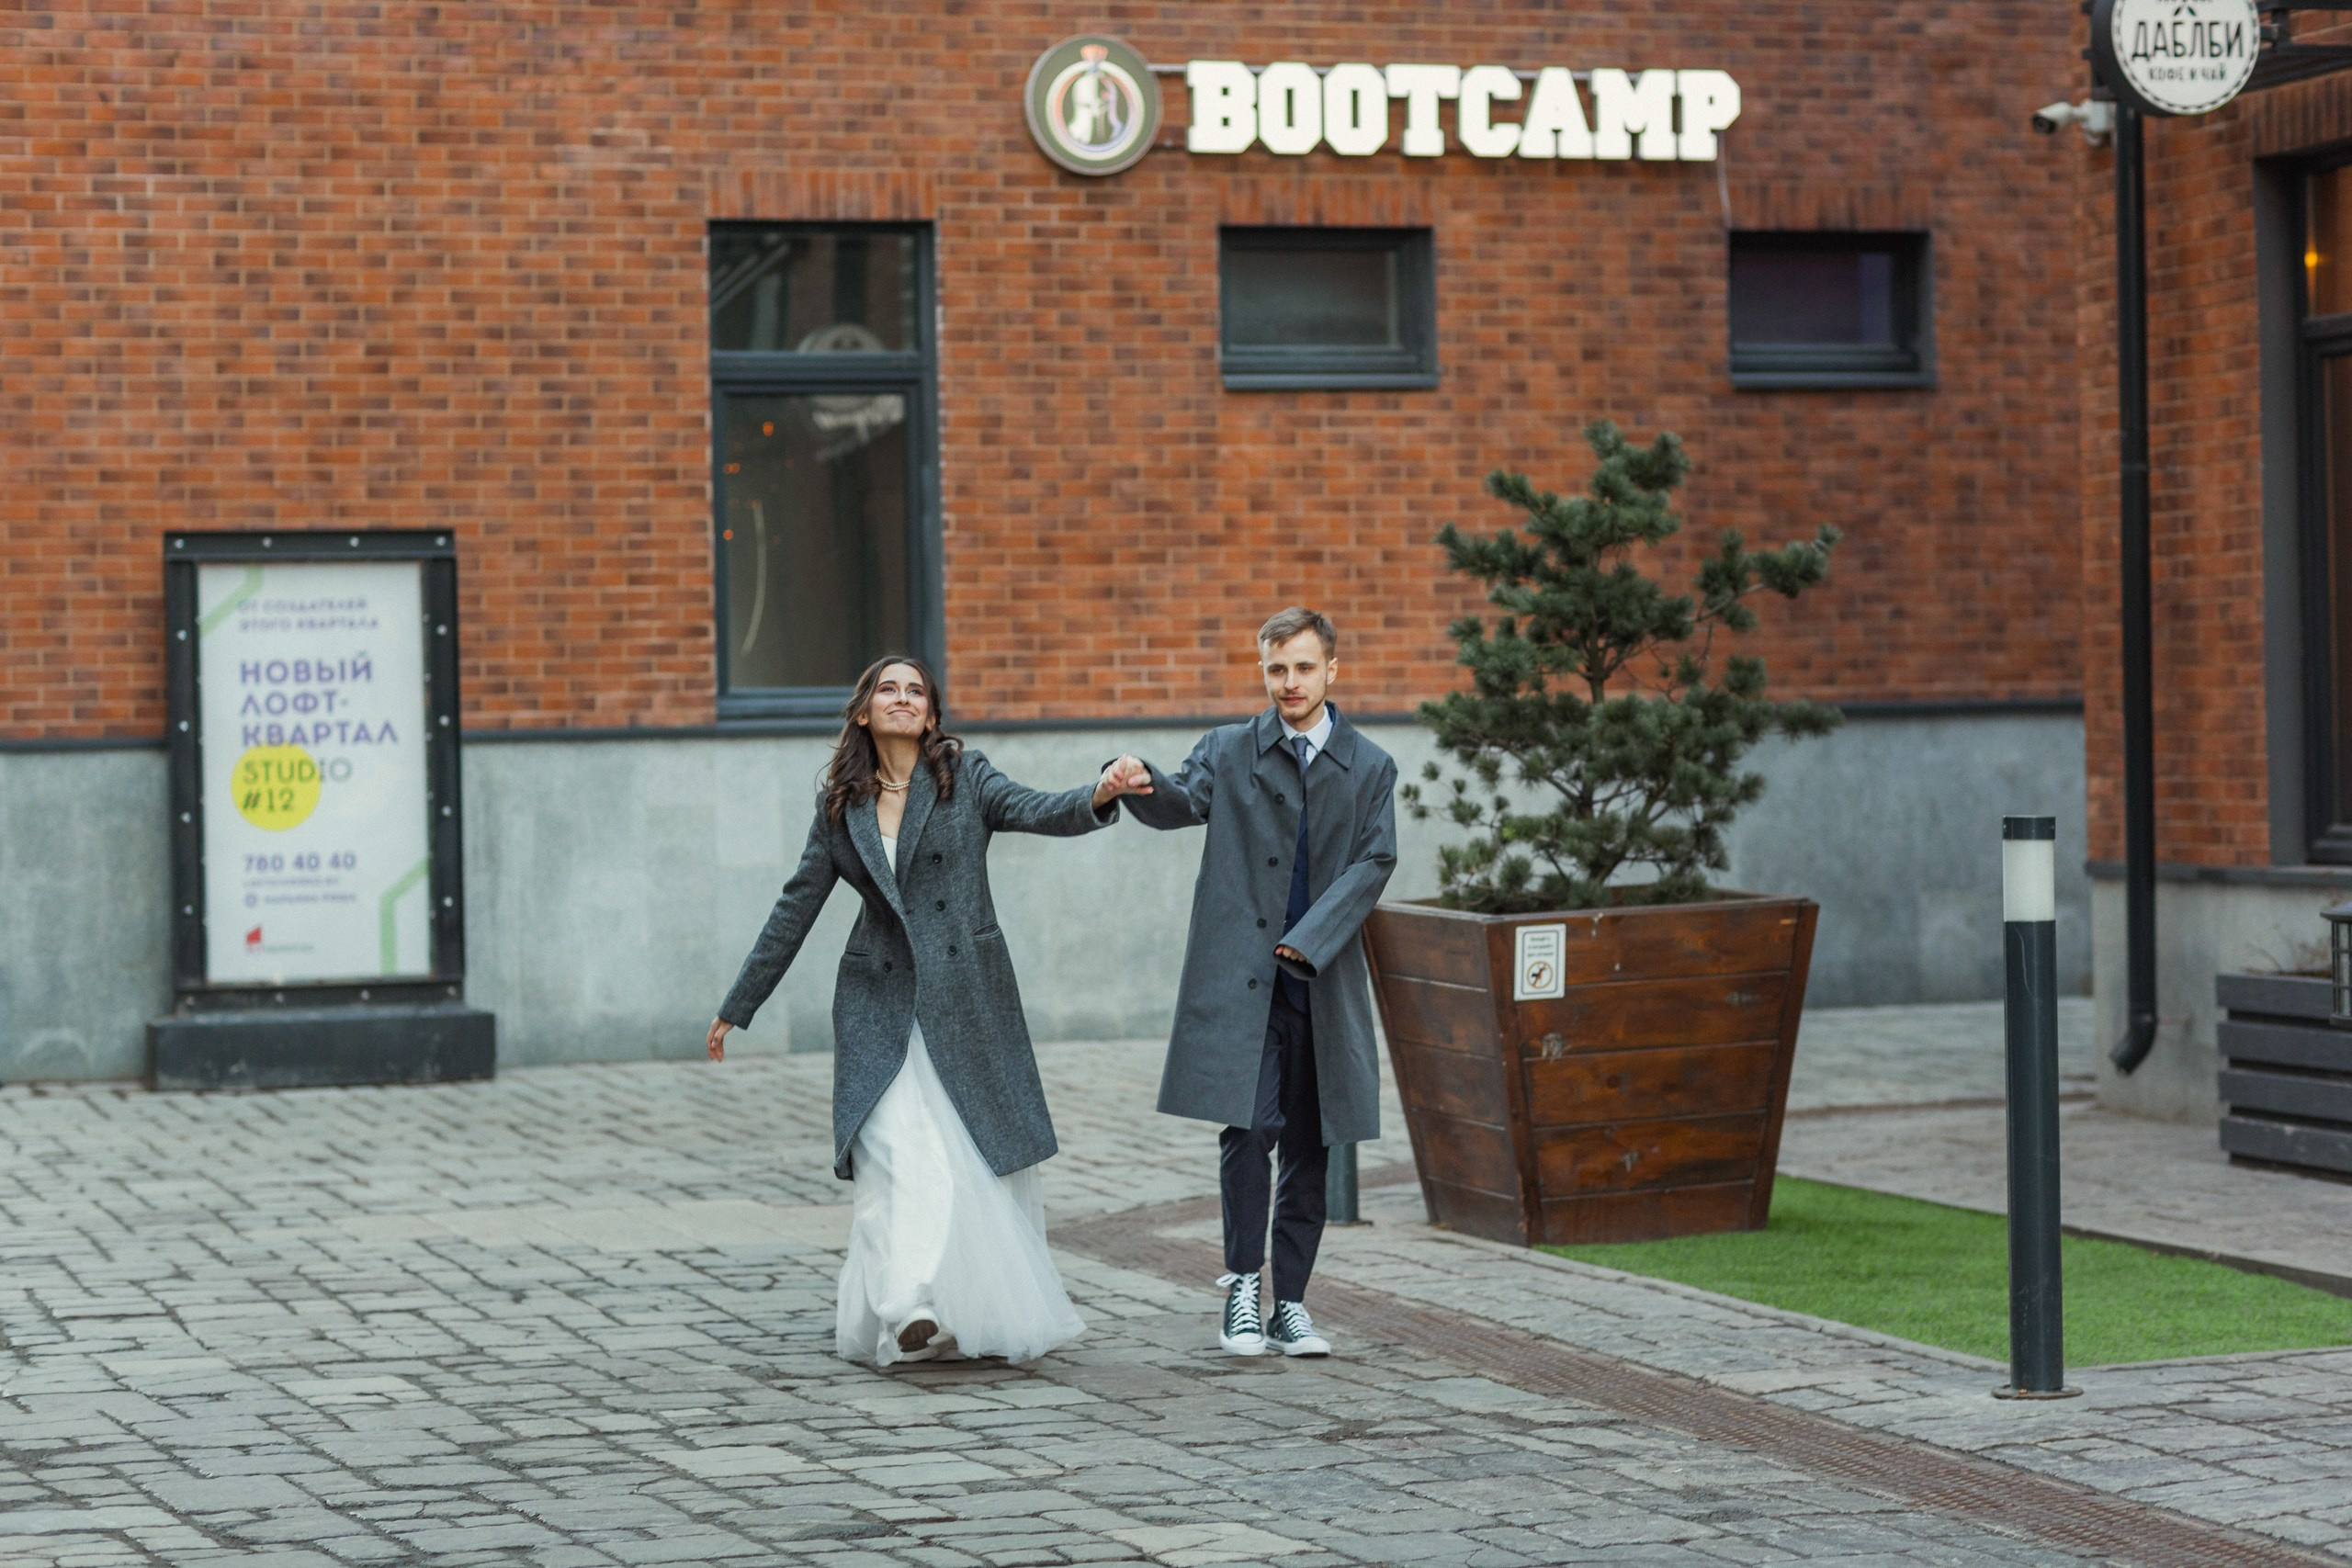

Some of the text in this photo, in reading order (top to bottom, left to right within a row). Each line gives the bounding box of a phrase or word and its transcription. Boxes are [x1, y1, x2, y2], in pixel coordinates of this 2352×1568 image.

[2132, 21, 2244, 62] ДАБЛБИ
[2150, 63, 2226, 81] КОФЕ И ЧАЙ
[1187, 61, 1742, 161] BOOTCAMP
[241, 650, 372, 683] НОВЫЙ
[243, 720, 398, 747] КВАРТАЛ
[243, 758, 353, 784] STUDIO
[243, 788, 295, 812] #12
